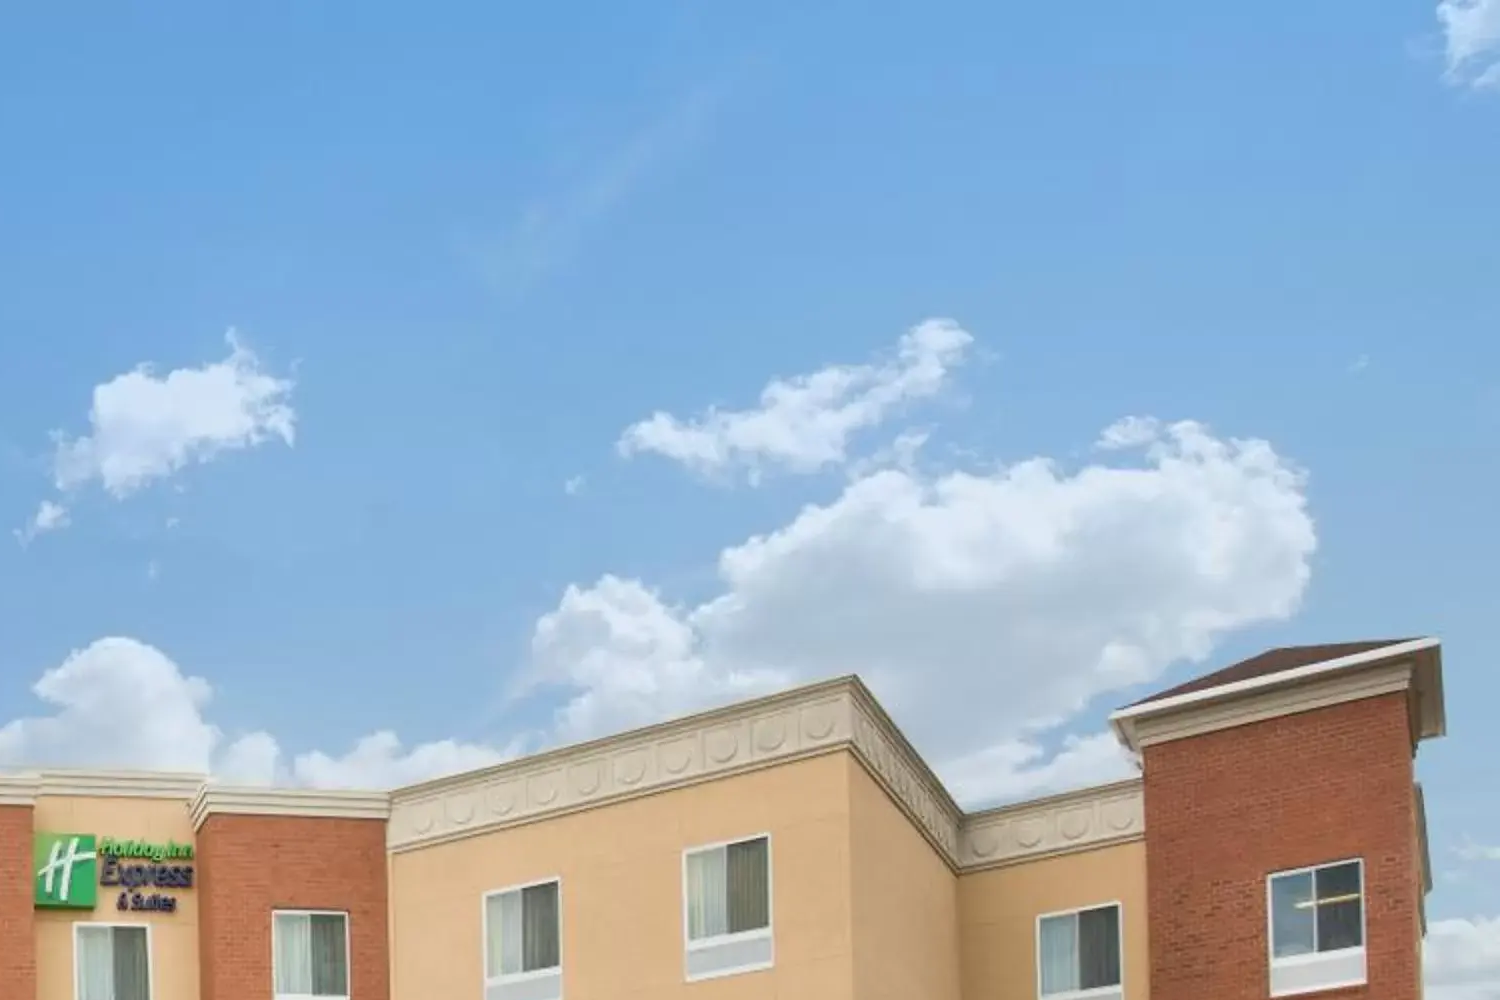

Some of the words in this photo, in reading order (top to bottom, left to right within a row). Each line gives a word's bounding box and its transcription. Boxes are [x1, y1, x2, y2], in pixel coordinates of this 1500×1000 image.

[100, 836, 165, 863] Holiday
[166, 839, 192, 860] Inn
[100, 854, 193, 891] Express
[131, 893, 177, 913] Suites
